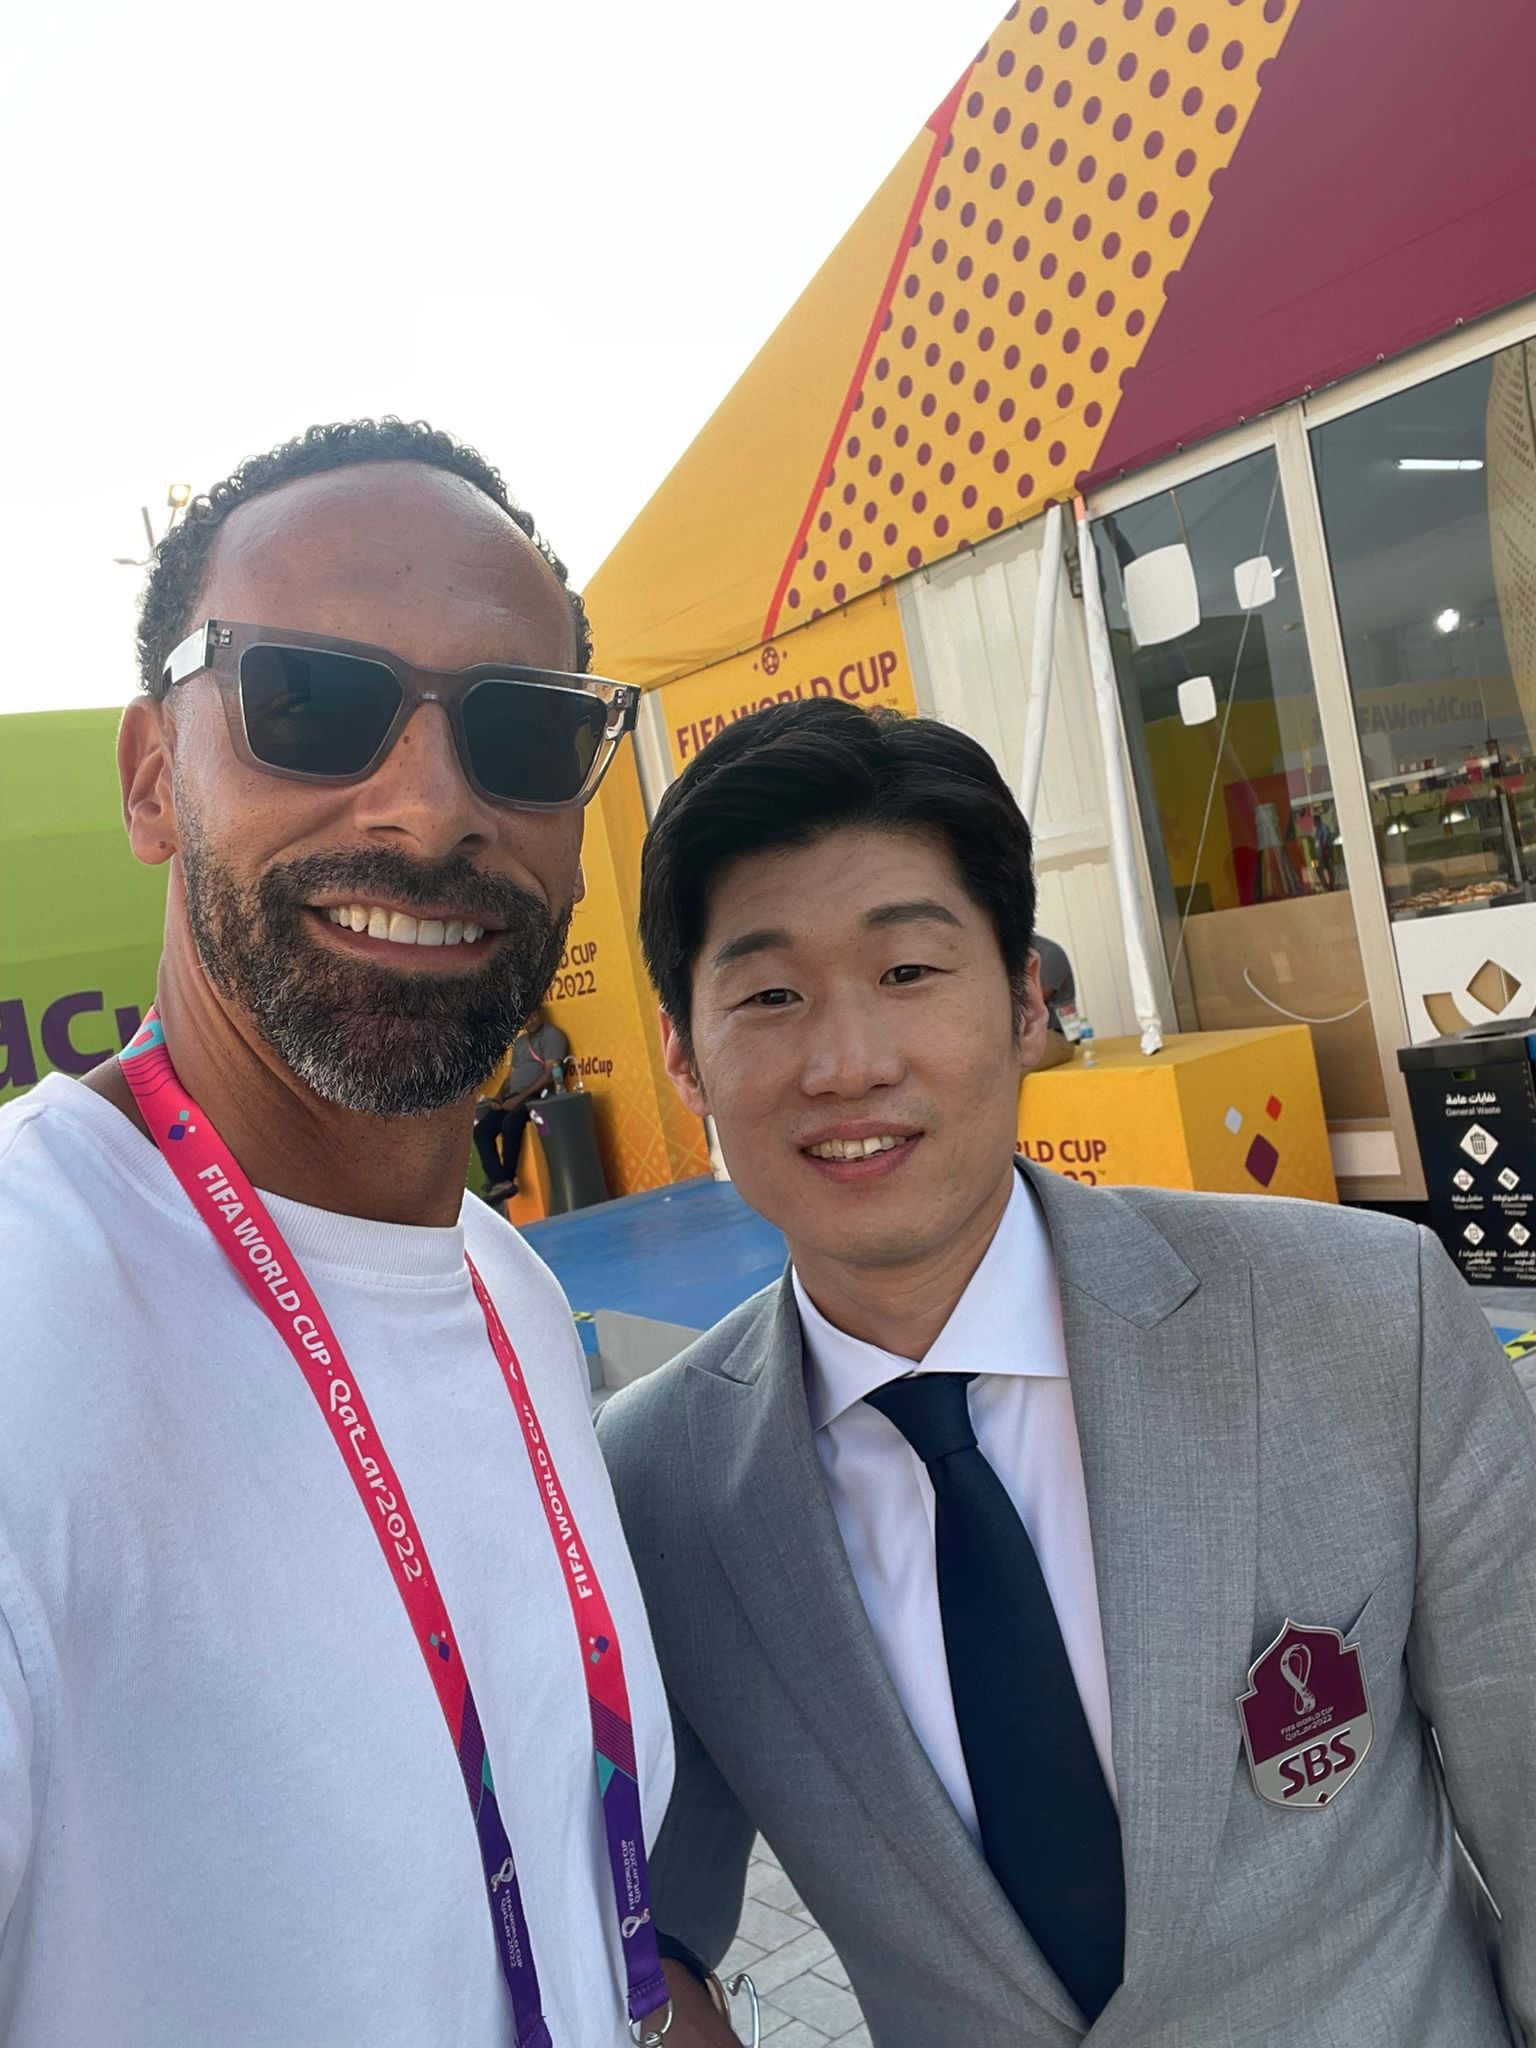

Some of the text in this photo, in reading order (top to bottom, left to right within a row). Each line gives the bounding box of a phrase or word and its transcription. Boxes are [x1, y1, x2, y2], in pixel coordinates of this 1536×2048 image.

[839, 650, 897, 700] CUP
[572, 941, 597, 963] CUP
[1059, 1139, 1107, 1163] CUP
[197, 1163, 246, 1224] FIFA
[233, 1216, 301, 1313] WORLD
[292, 1315, 332, 1367] CUP
[536, 1449, 572, 1540] WORLD
[565, 1540, 593, 1599] FIFA
[1278, 1727, 1357, 1799] SBS
